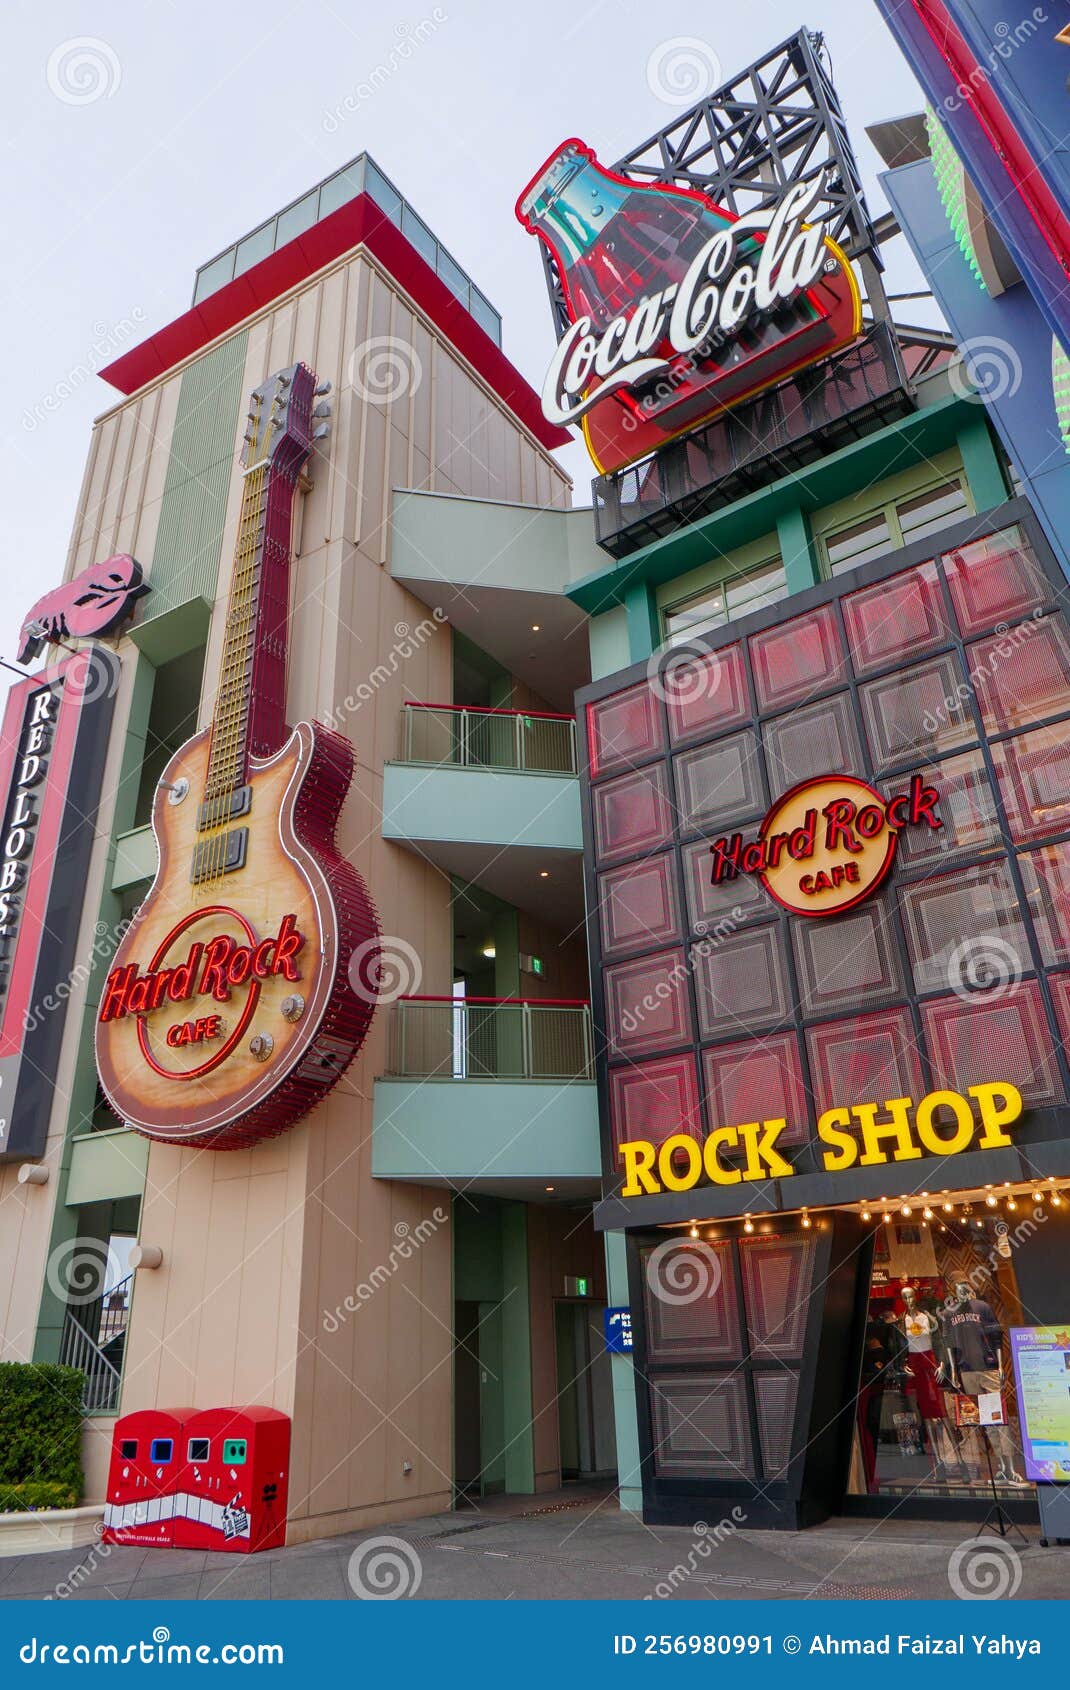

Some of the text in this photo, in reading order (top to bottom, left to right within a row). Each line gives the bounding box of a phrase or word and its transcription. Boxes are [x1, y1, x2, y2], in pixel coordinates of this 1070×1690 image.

[541, 167, 828, 427] Coca-Cola
[18, 691, 51, 787] RED
[710, 773, 943, 885] Hard Rock
[798, 861, 861, 895] CAFE
[100, 914, 306, 1022] Hard Rock
[166, 1014, 221, 1047] CAFE
[618, 1081, 1024, 1198] ROCK SHOP
